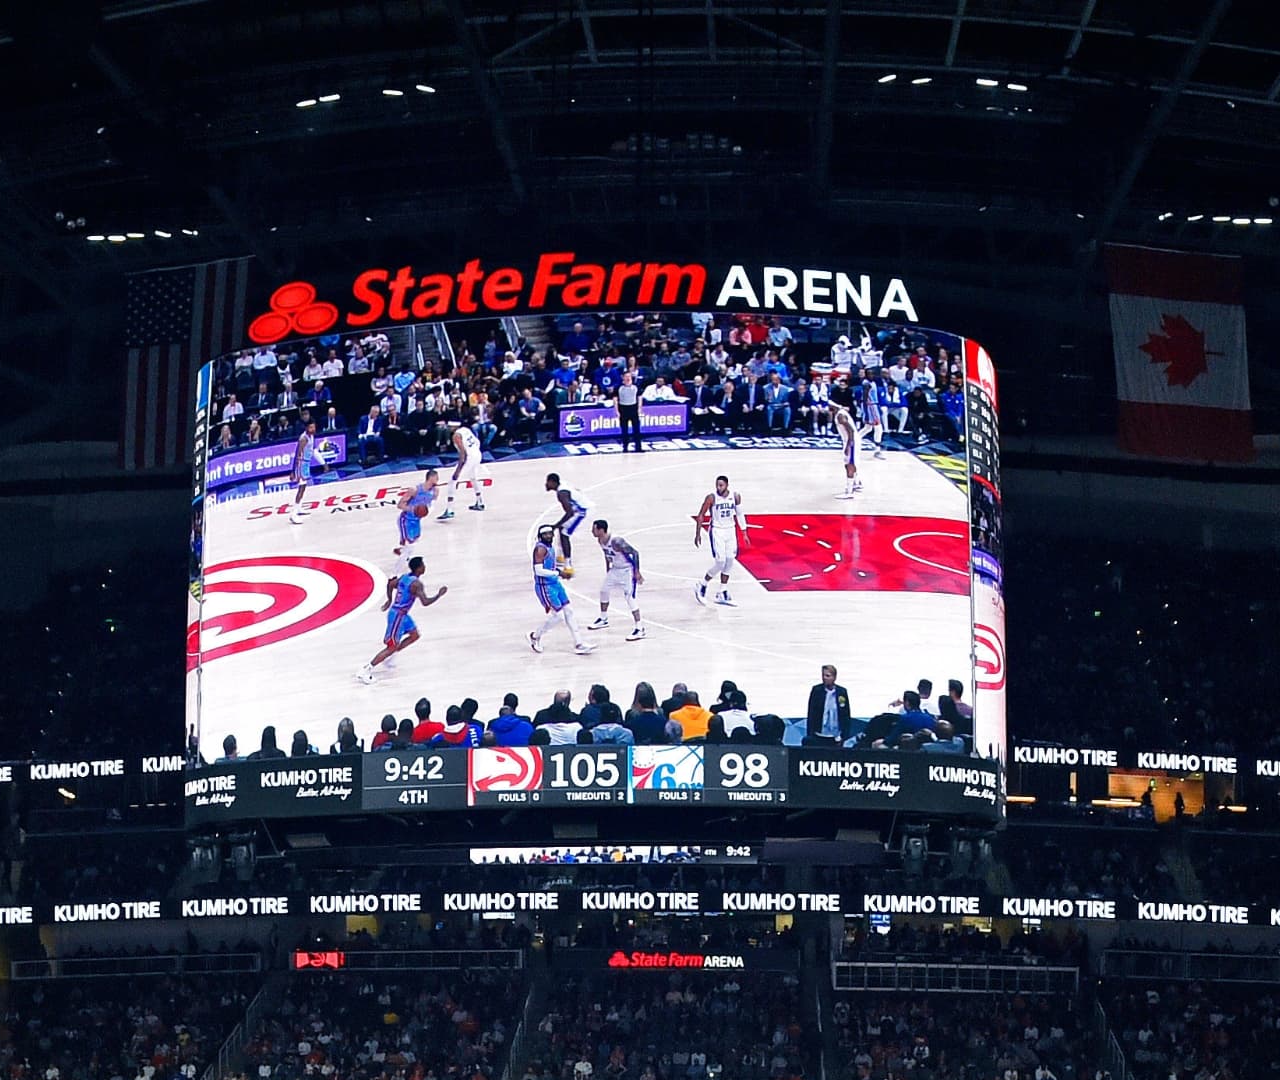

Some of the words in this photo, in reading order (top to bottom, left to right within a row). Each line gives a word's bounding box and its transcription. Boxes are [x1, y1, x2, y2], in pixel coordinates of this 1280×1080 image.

[346, 258, 523, 326] State
[528, 252, 707, 308] Farm
[716, 265, 919, 322] ARENA
[224, 458, 253, 476] free
[255, 454, 291, 471] zone
[1014, 746, 1078, 765] KUMHO
[1080, 749, 1118, 767] TIRE
[1137, 752, 1200, 772] KUMHO
[1202, 755, 1238, 774] TIRE
[30, 761, 89, 780] KUMHO
[91, 759, 124, 777] TIRE
[260, 769, 317, 788] KUMHO
[319, 766, 353, 784] TIRE
[384, 756, 444, 781] 9:42
[550, 753, 620, 788] 105
[719, 753, 770, 788] 98
[799, 760, 862, 778] KUMHO
[864, 762, 900, 779] TIRE
[928, 765, 979, 785] KUMHO
[209, 774, 236, 792] TIRE
[399, 789, 428, 804] 4TH
[498, 792, 527, 803] FOULS
[532, 792, 540, 801] 0
[566, 792, 611, 801] TIMEOUTS
[617, 792, 625, 801] 2
[659, 792, 688, 801] FOULS
[693, 792, 700, 801] 2
[727, 792, 772, 801] TIMEOUTS
[779, 793, 786, 802] 3
[726, 845, 751, 857] 9:42
[182, 897, 247, 917] KUMHO
[250, 896, 289, 915] TIRE
[310, 894, 378, 913] KUMHO
[381, 893, 421, 912] TIRE
[443, 892, 515, 911] KUMHO
[517, 892, 559, 910] TIRE
[582, 891, 654, 910] KUMHO
[657, 892, 699, 910] TIRE
[722, 892, 795, 911] KUMHO
[798, 893, 841, 912] TIRE
[863, 894, 935, 914] KUMHO
[938, 895, 980, 914] TIRE
[1002, 897, 1073, 917] KUMHO
[1076, 900, 1116, 919] TIRE
[54, 902, 120, 922] KUMHO
[122, 901, 161, 920] TIRE
[1138, 901, 1206, 922] KUMHO
[1209, 904, 1249, 924] TIRE
[631, 952, 667, 968] State
[668, 952, 704, 968] Farm
[704, 955, 745, 968] ARENA
